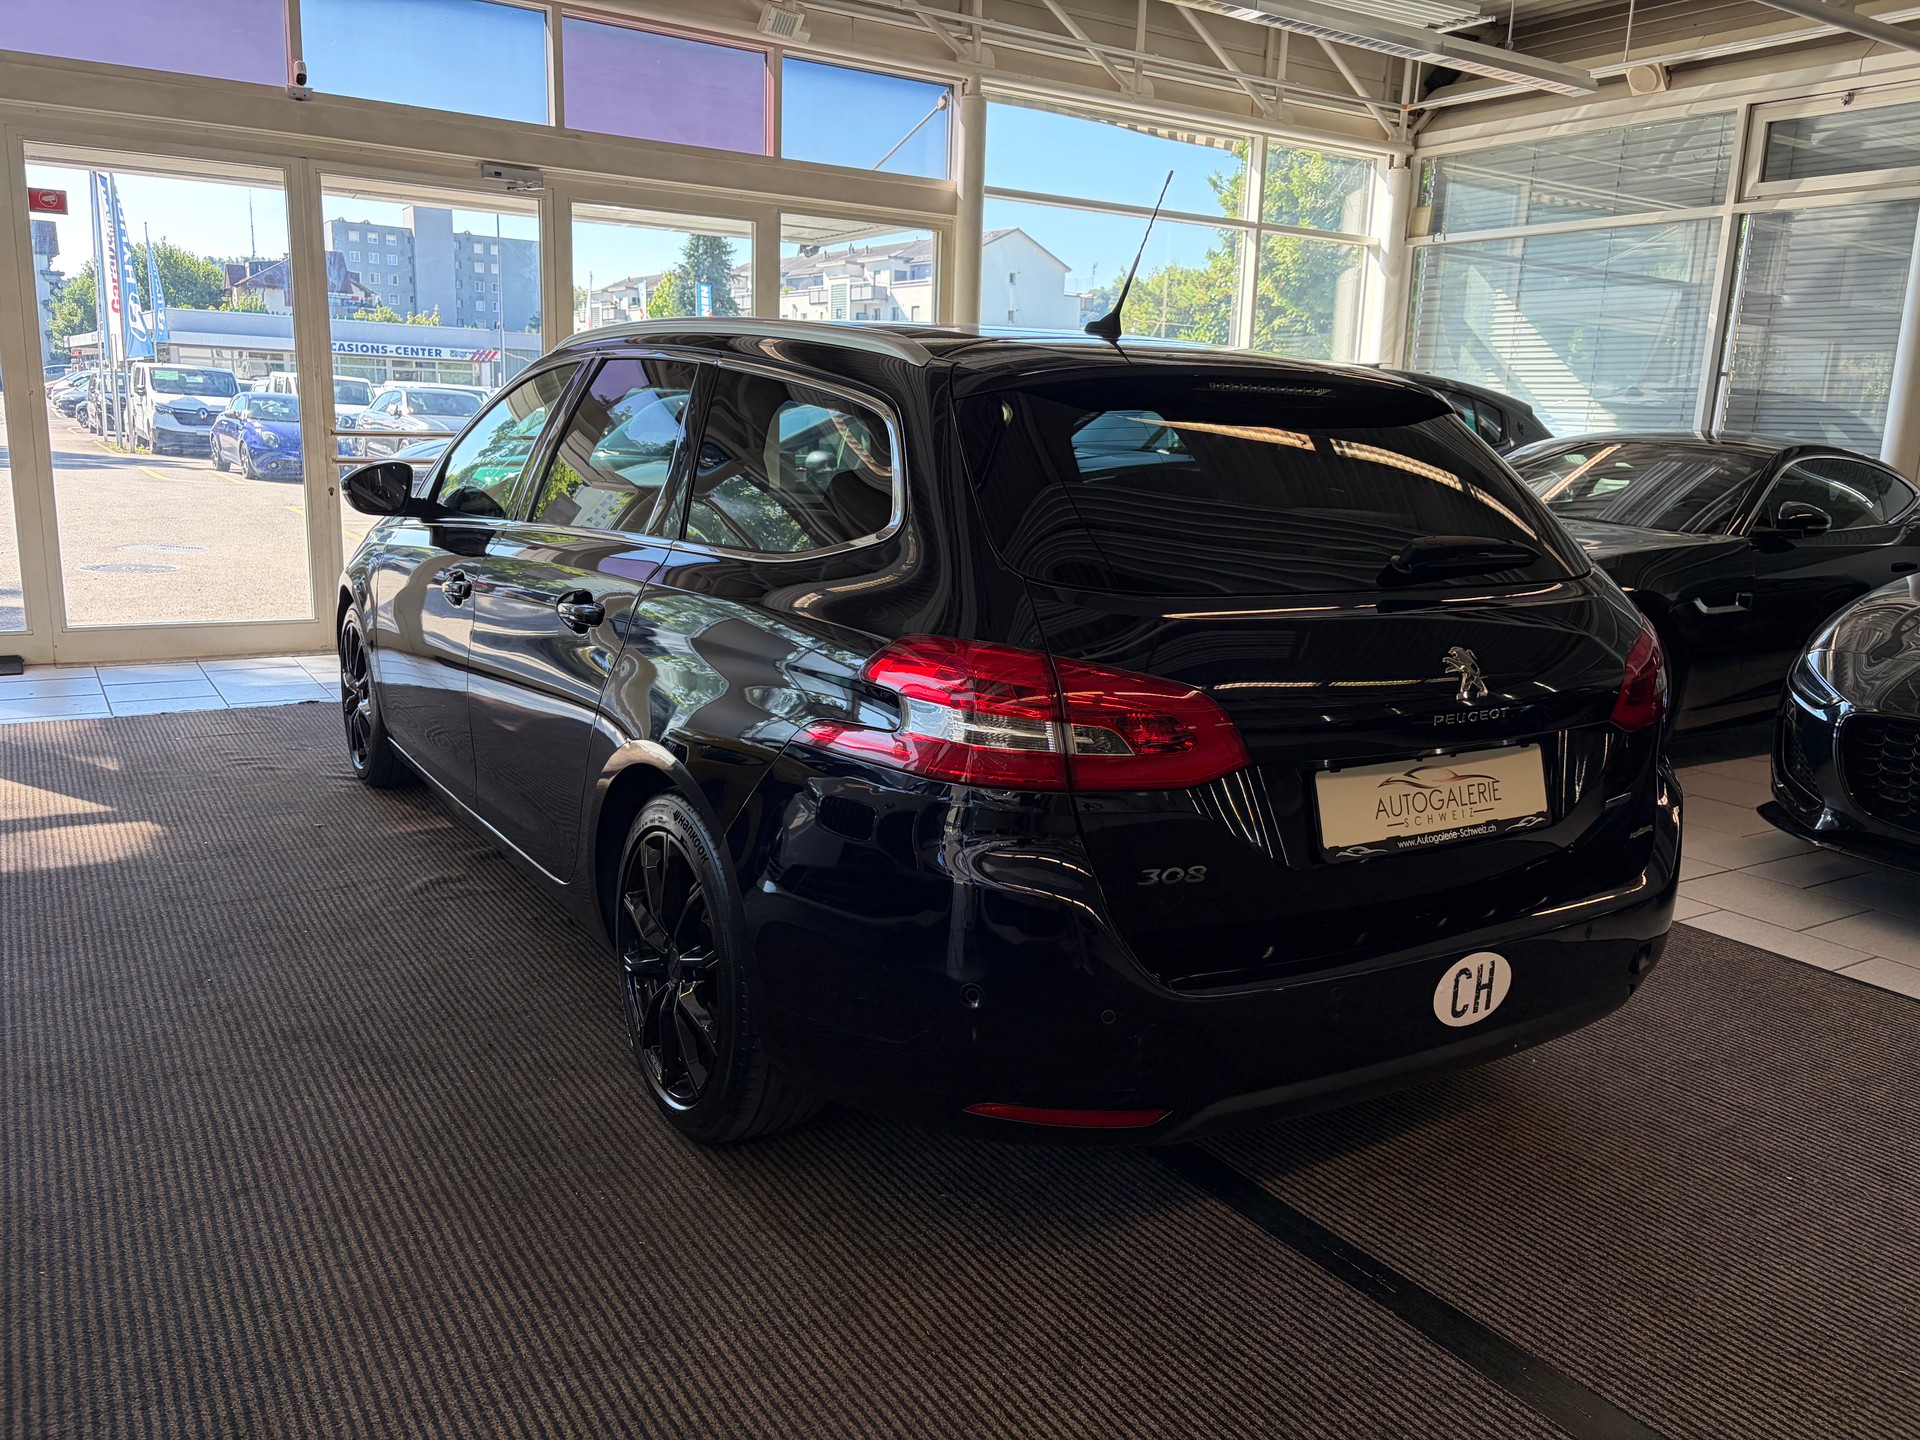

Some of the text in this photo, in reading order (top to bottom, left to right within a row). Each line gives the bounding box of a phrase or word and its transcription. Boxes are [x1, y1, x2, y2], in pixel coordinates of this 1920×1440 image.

[1433, 706, 1510, 727] PEUGEOT
[1375, 780, 1502, 820] AUTOGALERIE
[1404, 807, 1475, 829] SCHWEIZ
[1397, 824, 1497, 849] www.Autogalerie-Schweiz.ch
[1136, 865, 1208, 887] 308
[1450, 959, 1496, 1019] CH
